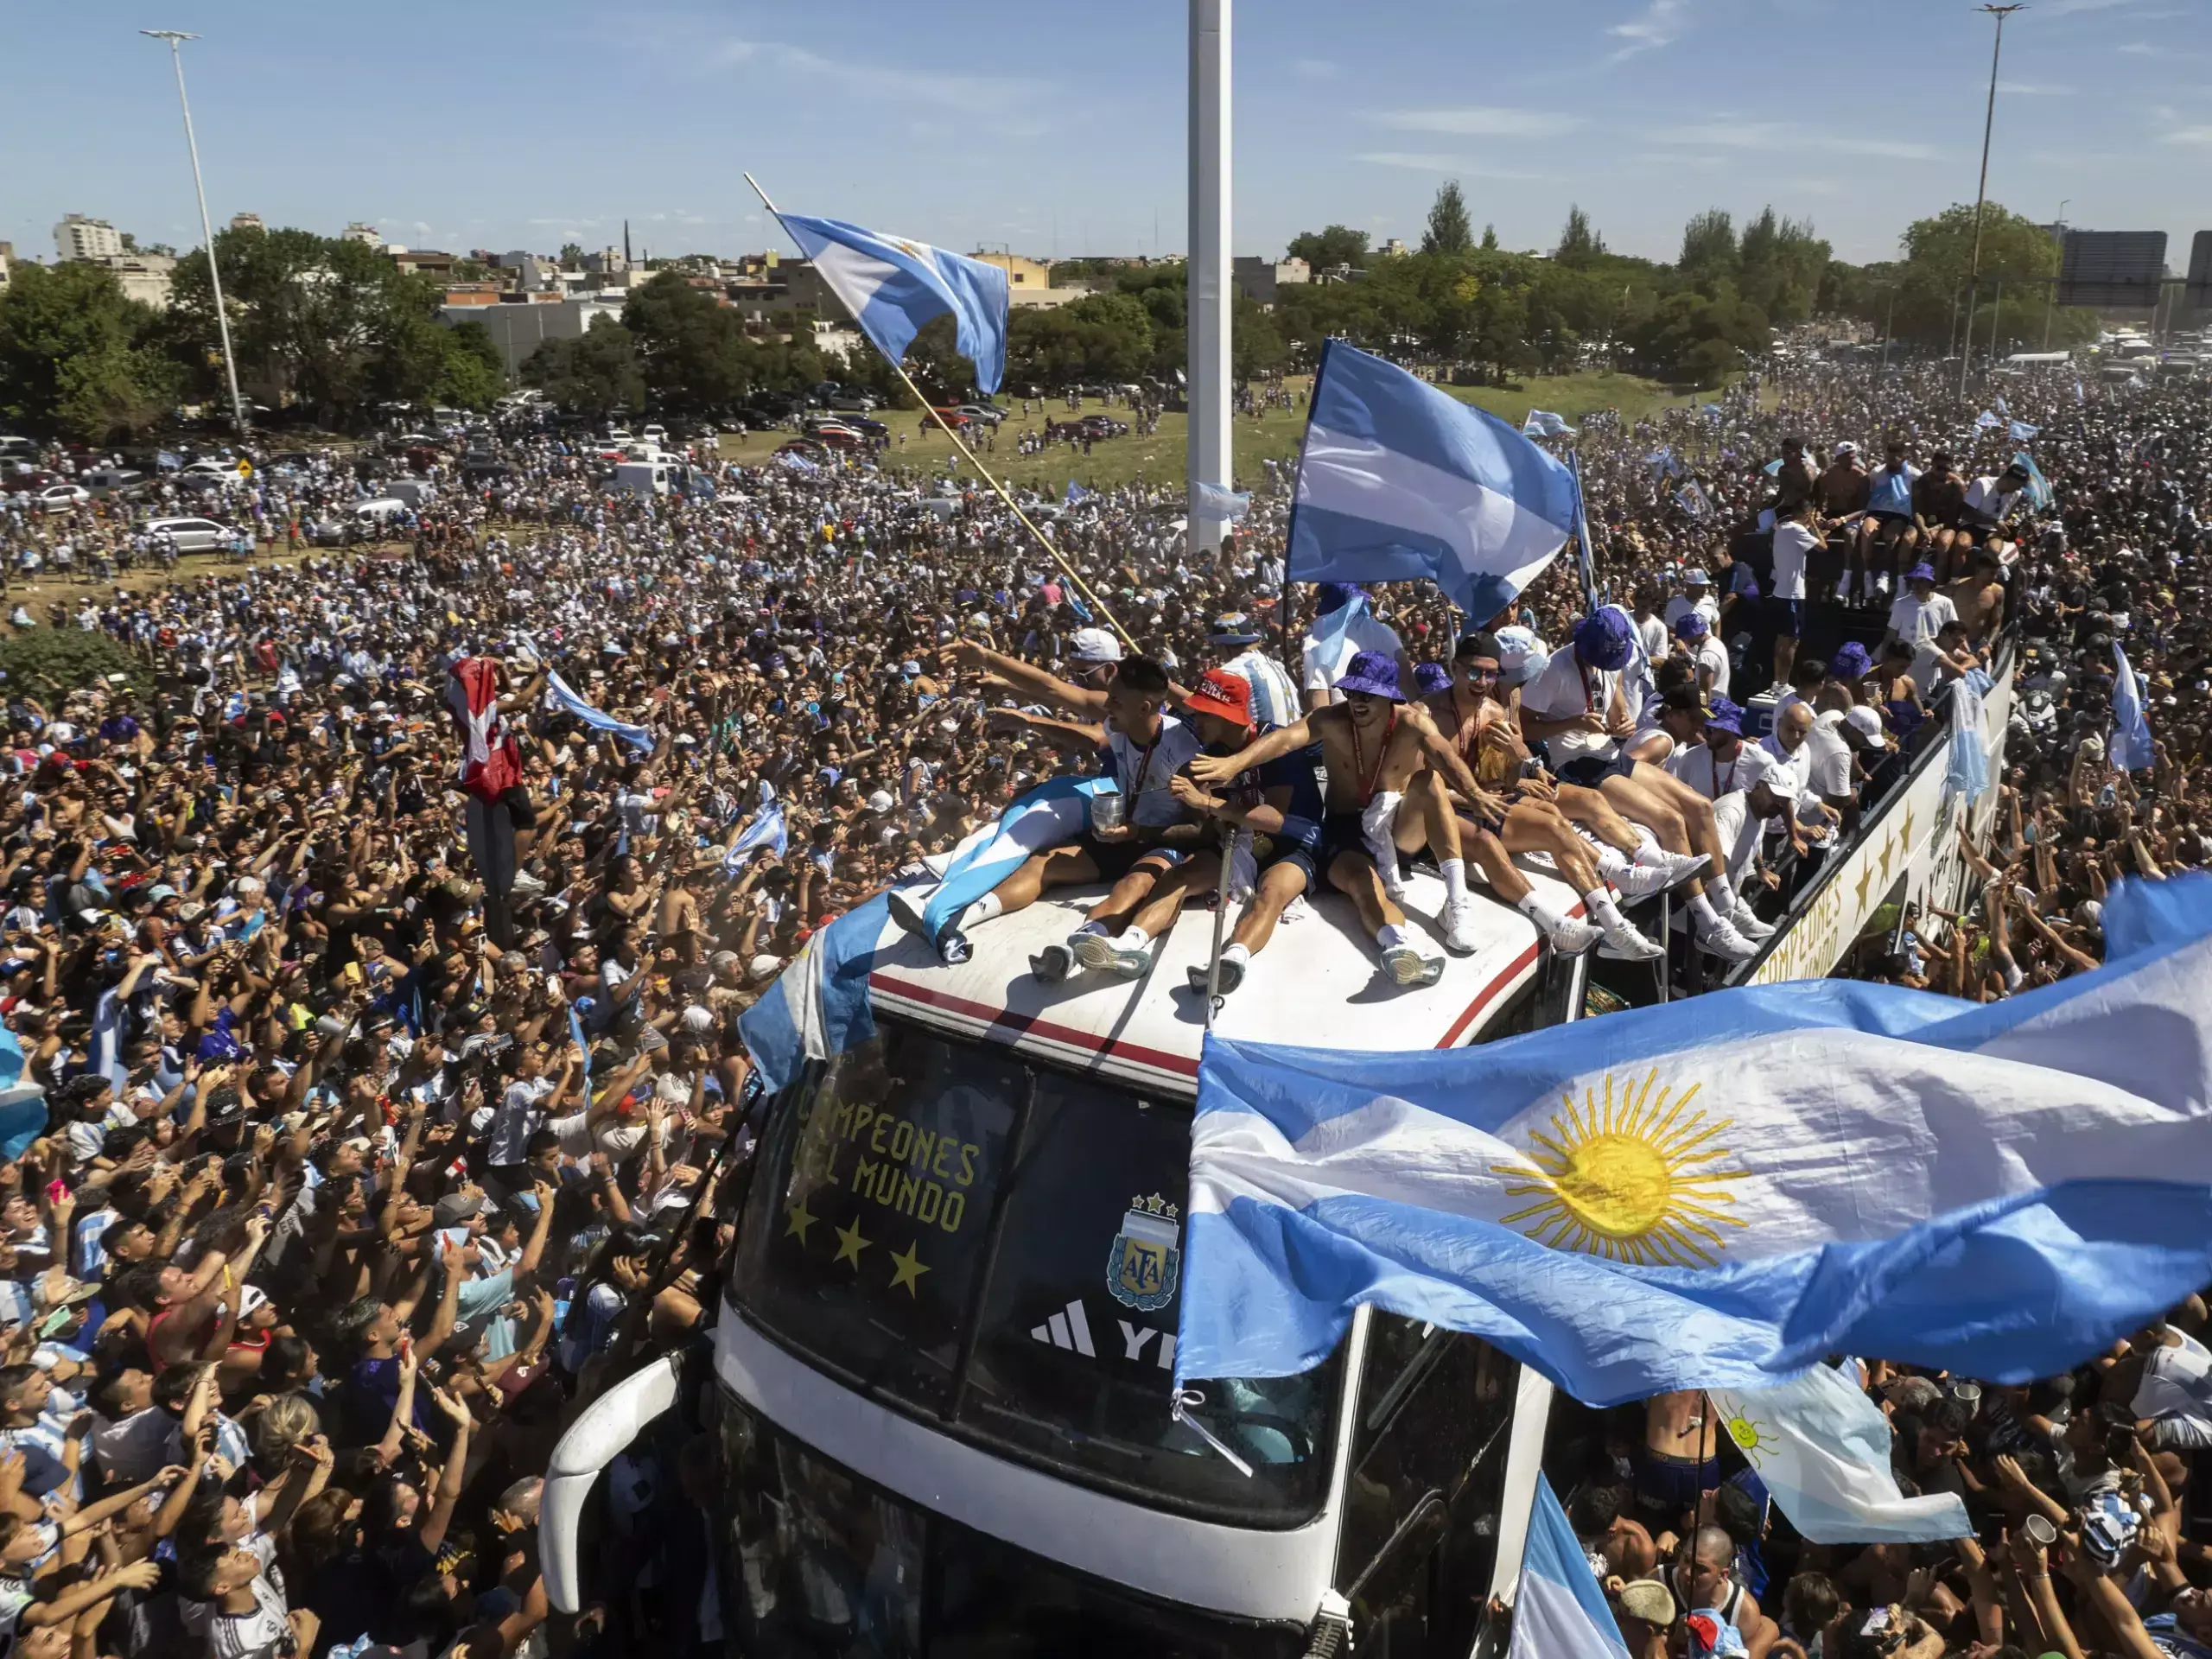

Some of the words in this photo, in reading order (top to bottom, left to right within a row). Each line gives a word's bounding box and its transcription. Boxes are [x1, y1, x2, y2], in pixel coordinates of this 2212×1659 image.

[1929, 842, 1951, 896] YPF
[798, 1084, 980, 1186] CMPEONES
[851, 1154, 965, 1233] MUNDO
[1124, 1243, 1160, 1290] AFA
